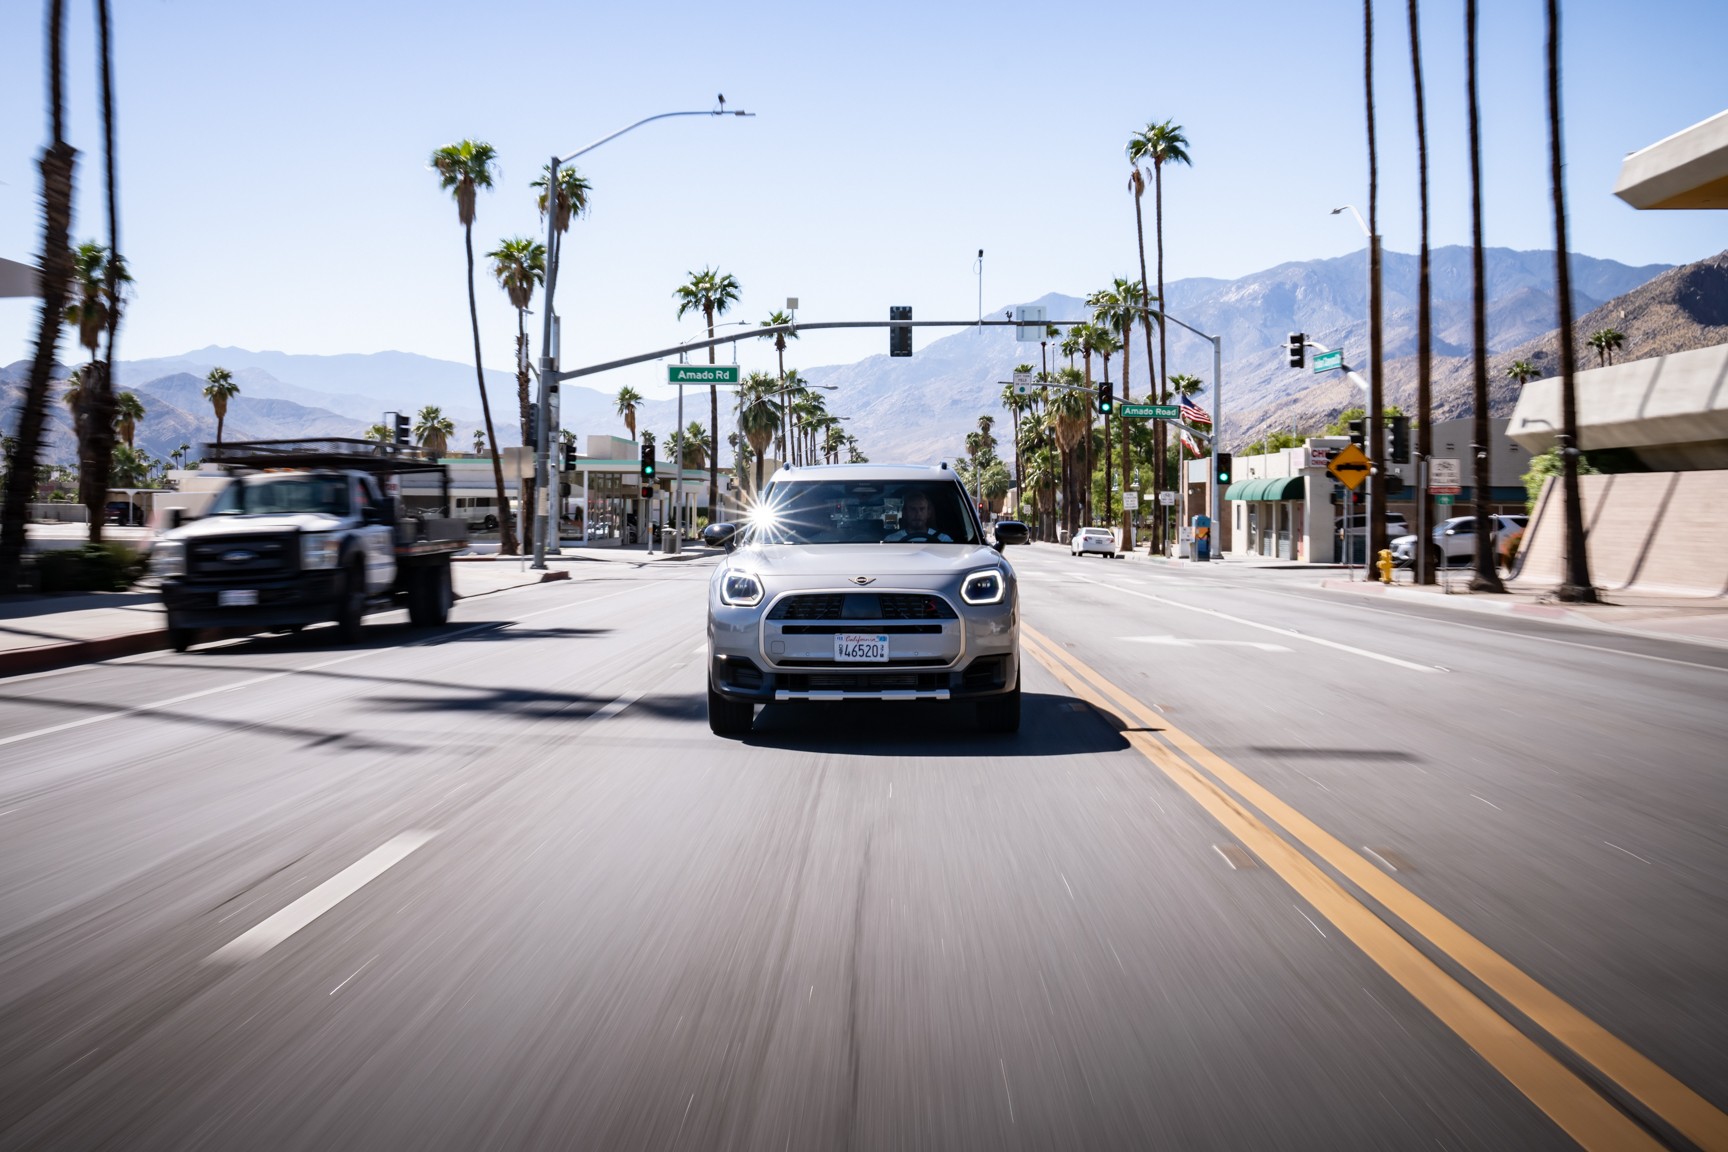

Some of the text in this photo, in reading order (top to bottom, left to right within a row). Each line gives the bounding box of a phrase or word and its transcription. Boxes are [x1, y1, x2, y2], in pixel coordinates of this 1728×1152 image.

[678, 370, 730, 380] Amado Rd
[1124, 407, 1177, 416] Amado Road
[845, 635, 876, 644] California
[844, 643, 879, 658] 46520
